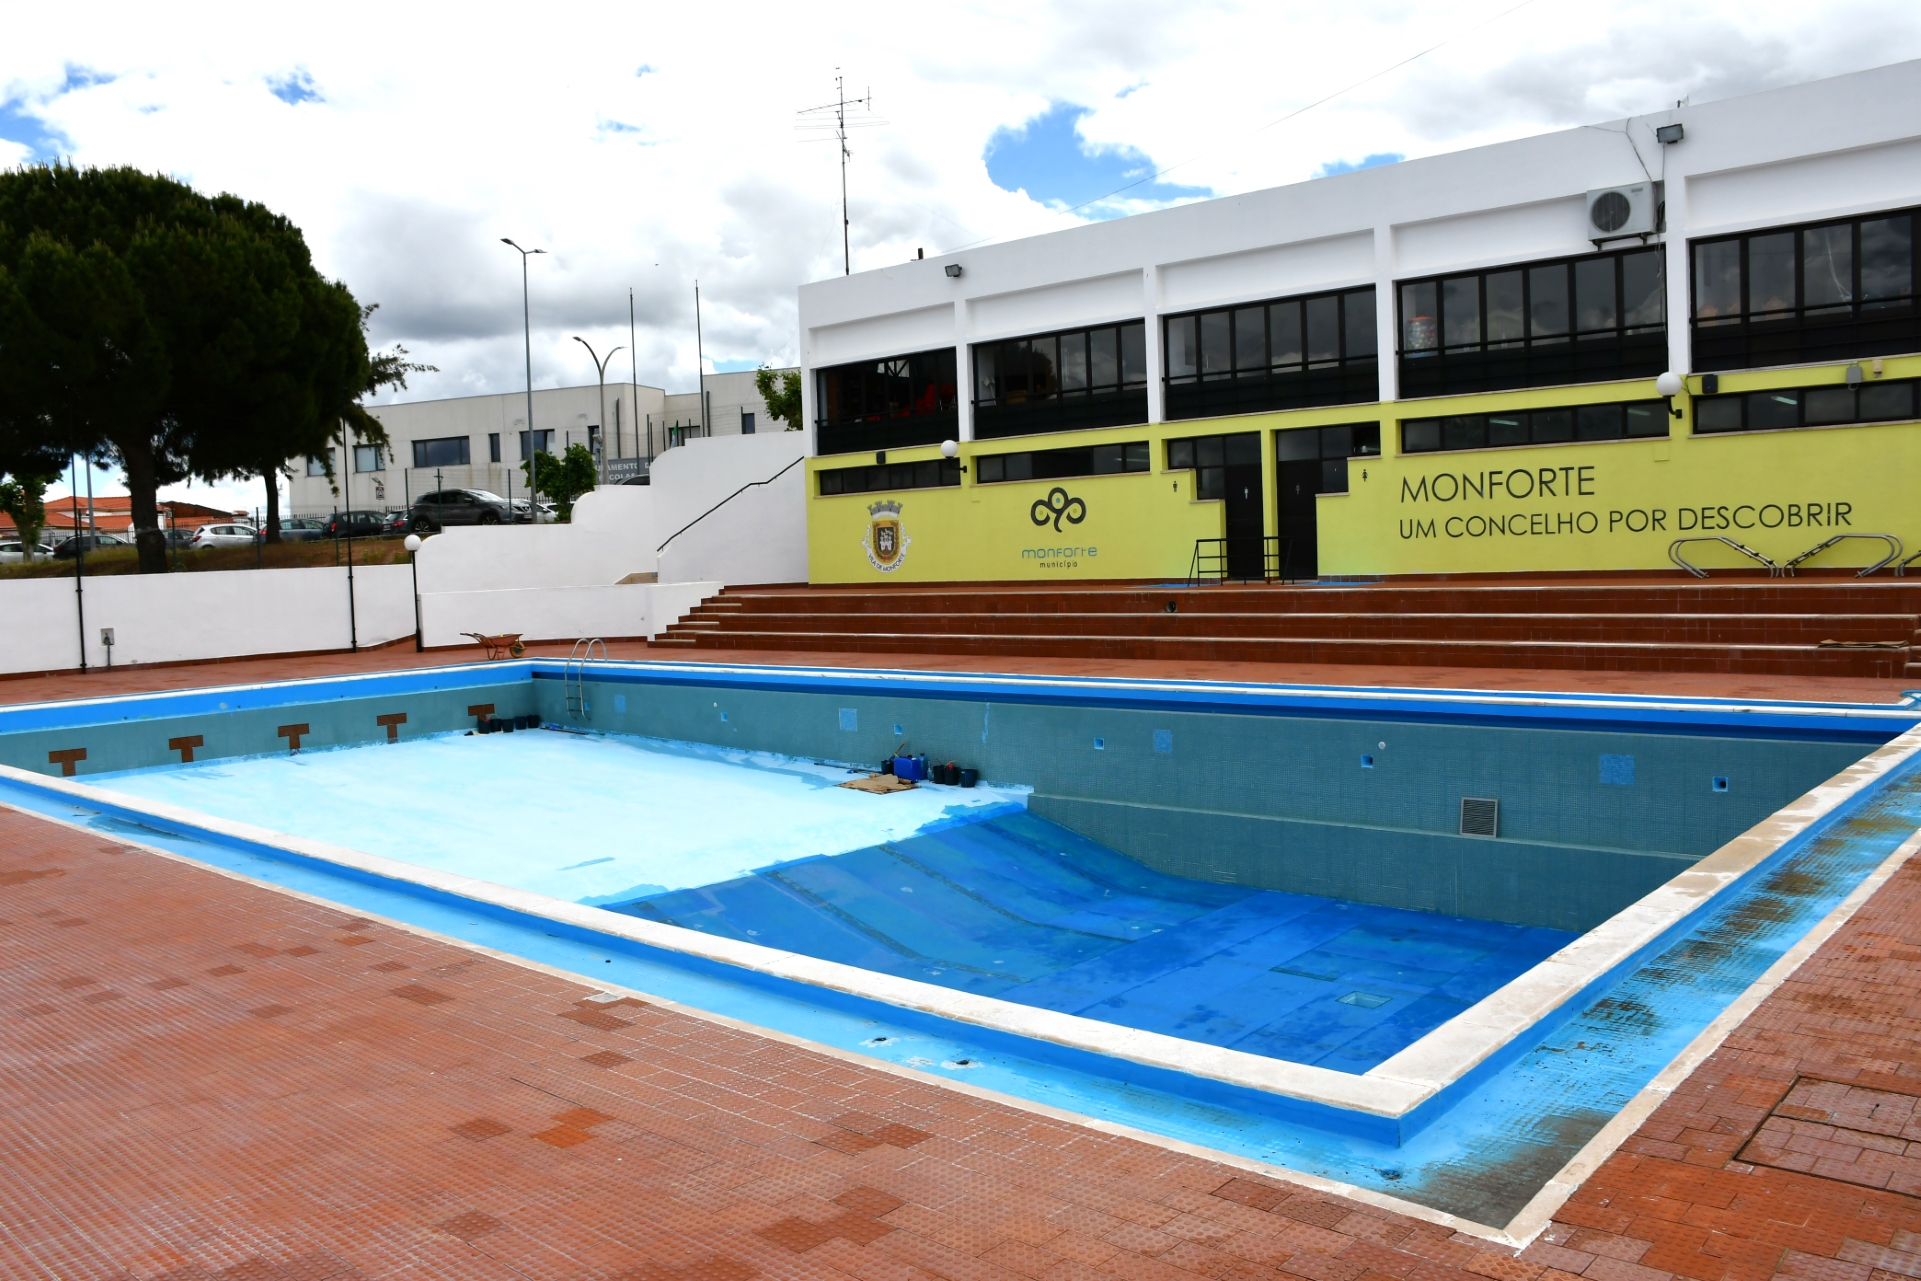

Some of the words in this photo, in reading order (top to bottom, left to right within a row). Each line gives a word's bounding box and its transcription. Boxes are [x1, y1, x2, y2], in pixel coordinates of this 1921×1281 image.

[1400, 465, 1596, 503] MONFORTE
[1399, 518, 1437, 540] UM
[1444, 511, 1599, 538] CONCELHO
[1608, 508, 1667, 533] POR
[1678, 502, 1853, 531] DESCOBRIR
[875, 563, 883, 571] DE
[882, 553, 906, 572] MONFORTE
